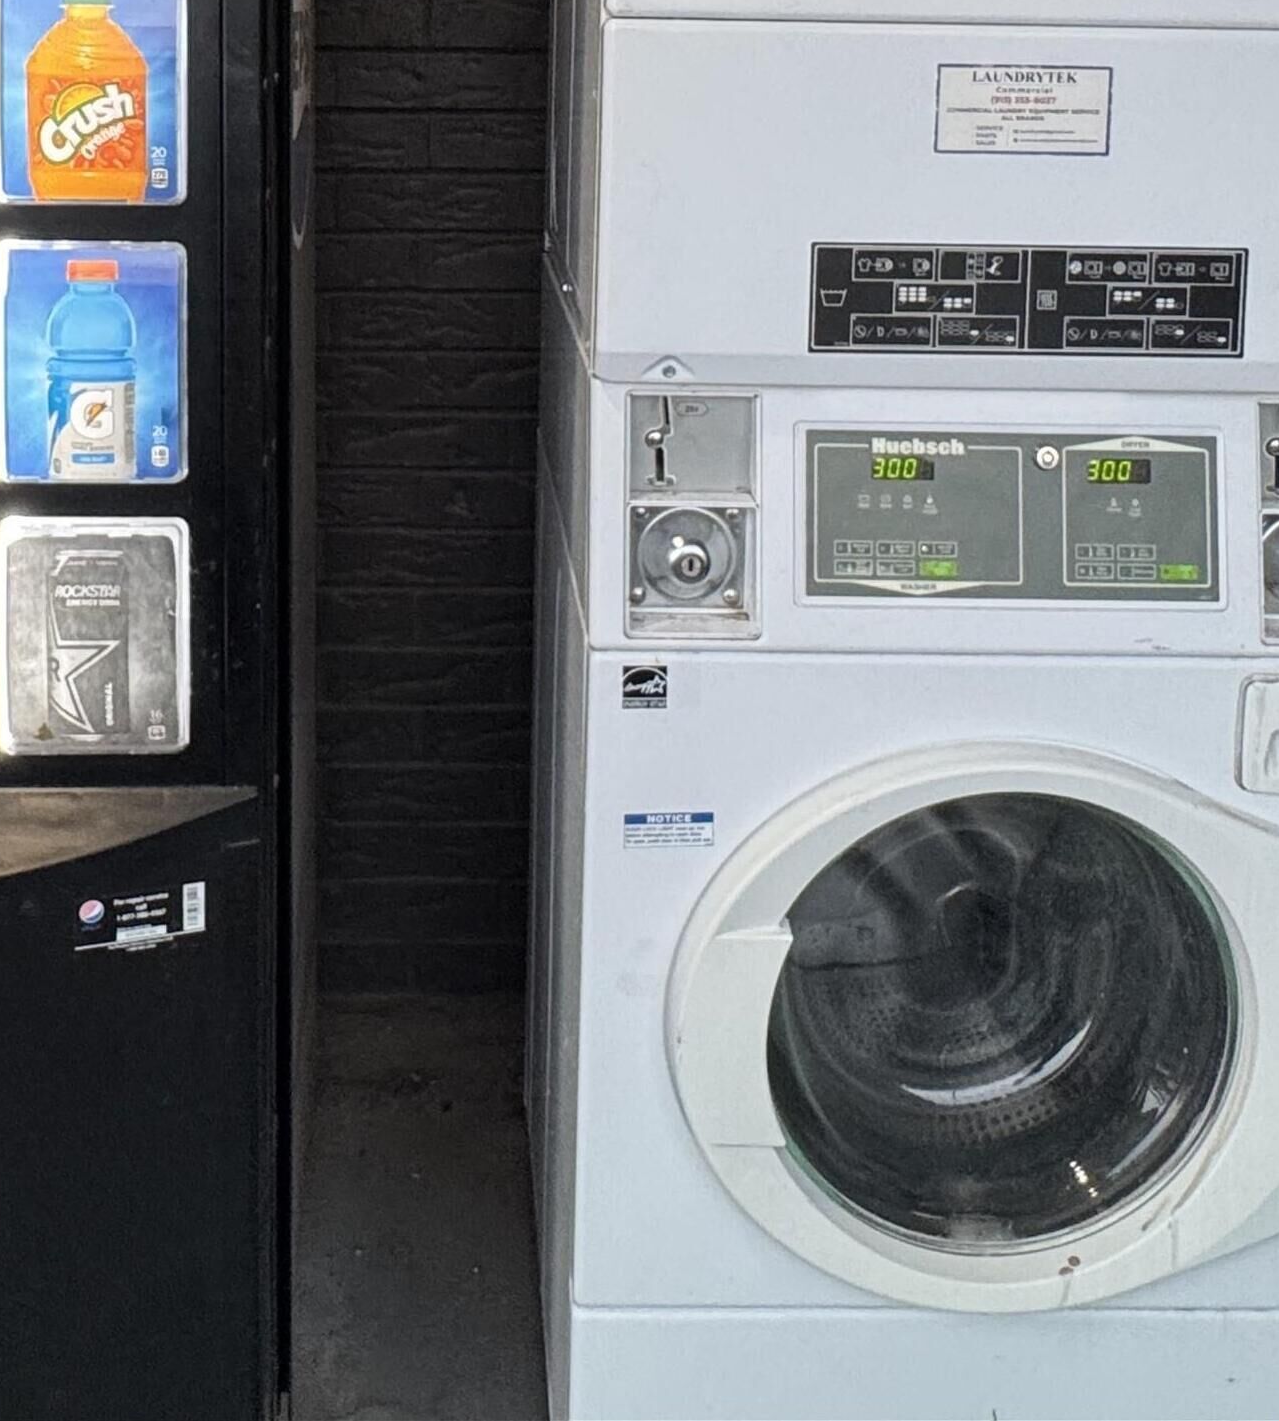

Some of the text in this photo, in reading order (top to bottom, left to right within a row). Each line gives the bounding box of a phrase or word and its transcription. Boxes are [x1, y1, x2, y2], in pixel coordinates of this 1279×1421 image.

[972, 71, 1077, 84] LAUNDRYTEK
[39, 83, 135, 162] Crush
[151, 147, 167, 158] 20
[153, 425, 168, 437] 20
[872, 437, 965, 455] Huebsch
[1121, 441, 1150, 449] DRYER
[873, 458, 917, 479] 300
[1087, 459, 1131, 481] 300
[55, 585, 121, 598] ROCKSTAR
[646, 814, 692, 823] NOTICE
